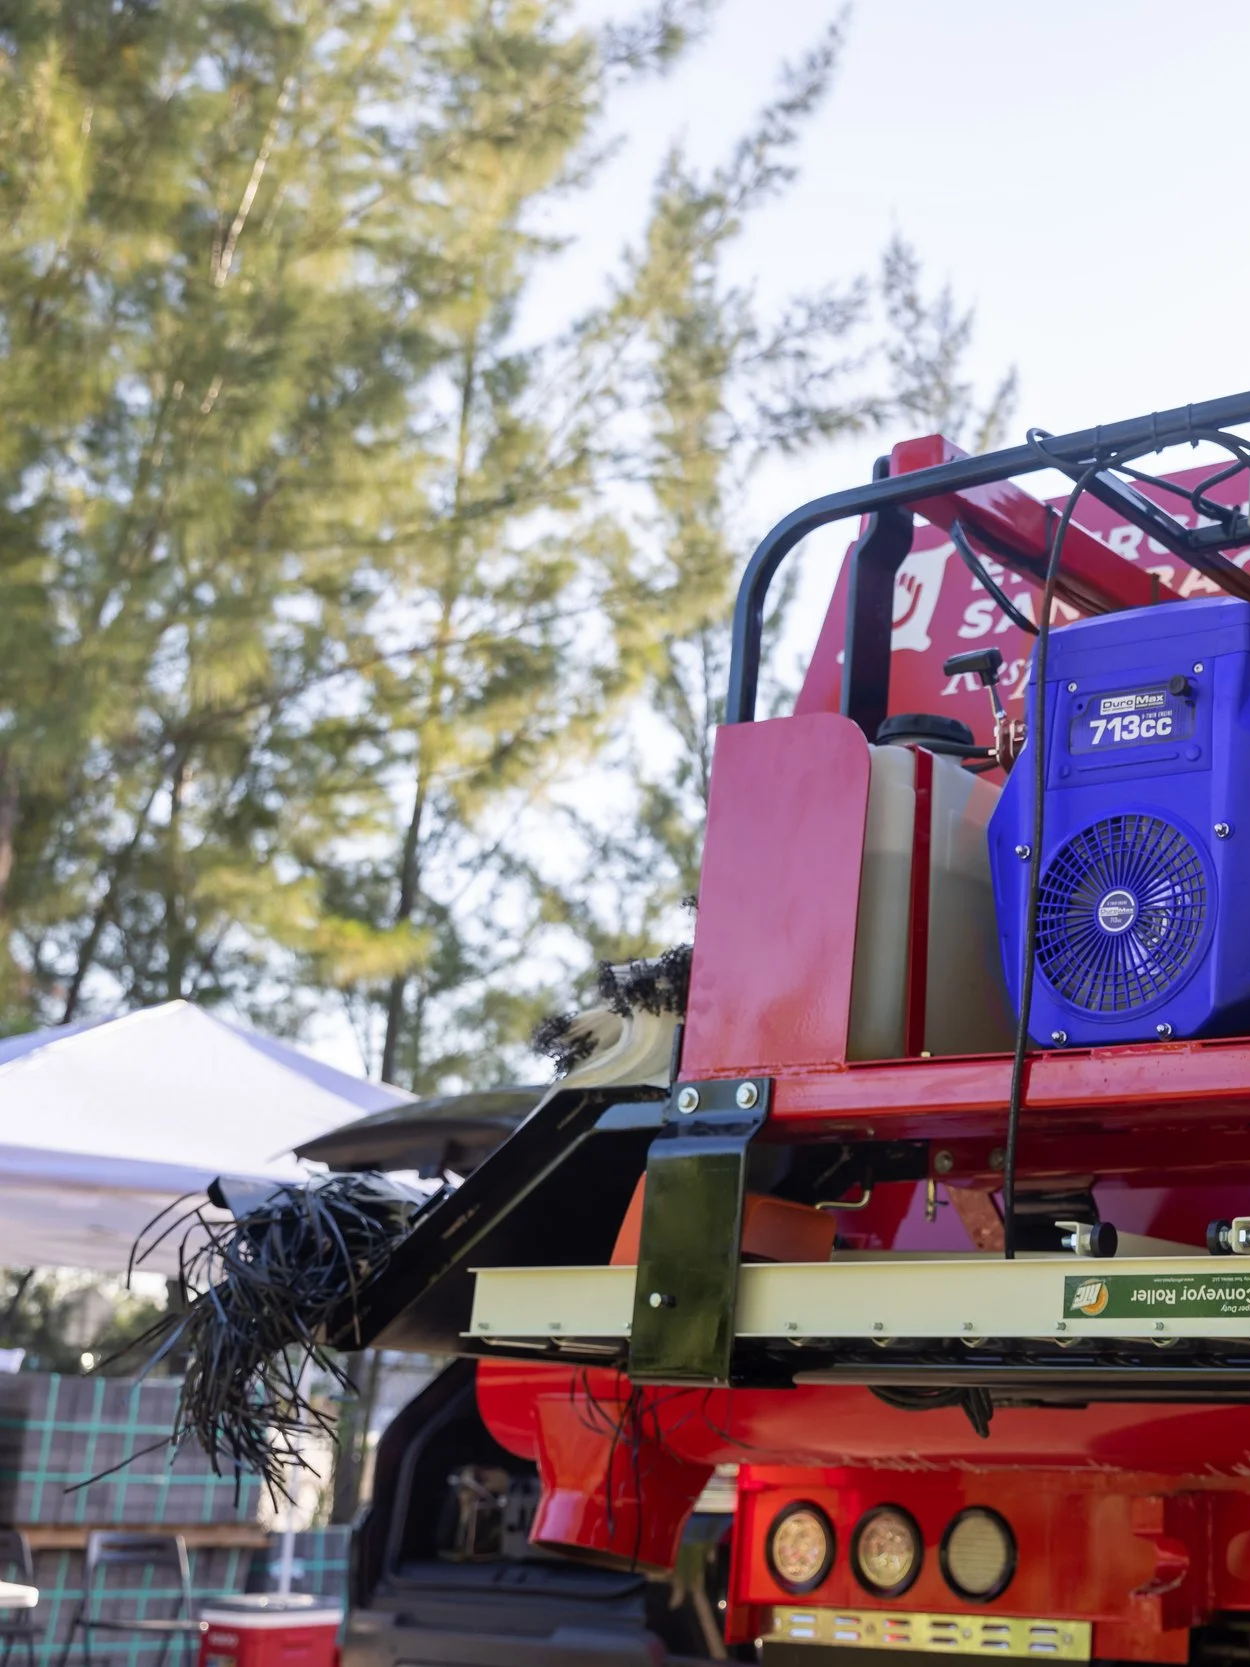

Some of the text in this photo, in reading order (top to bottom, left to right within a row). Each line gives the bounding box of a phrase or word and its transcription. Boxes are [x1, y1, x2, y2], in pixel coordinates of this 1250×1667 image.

[1089, 714, 1172, 745] 713cc
[1131, 1288, 1176, 1304] Roller
[1220, 1304, 1238, 1313] Duty
